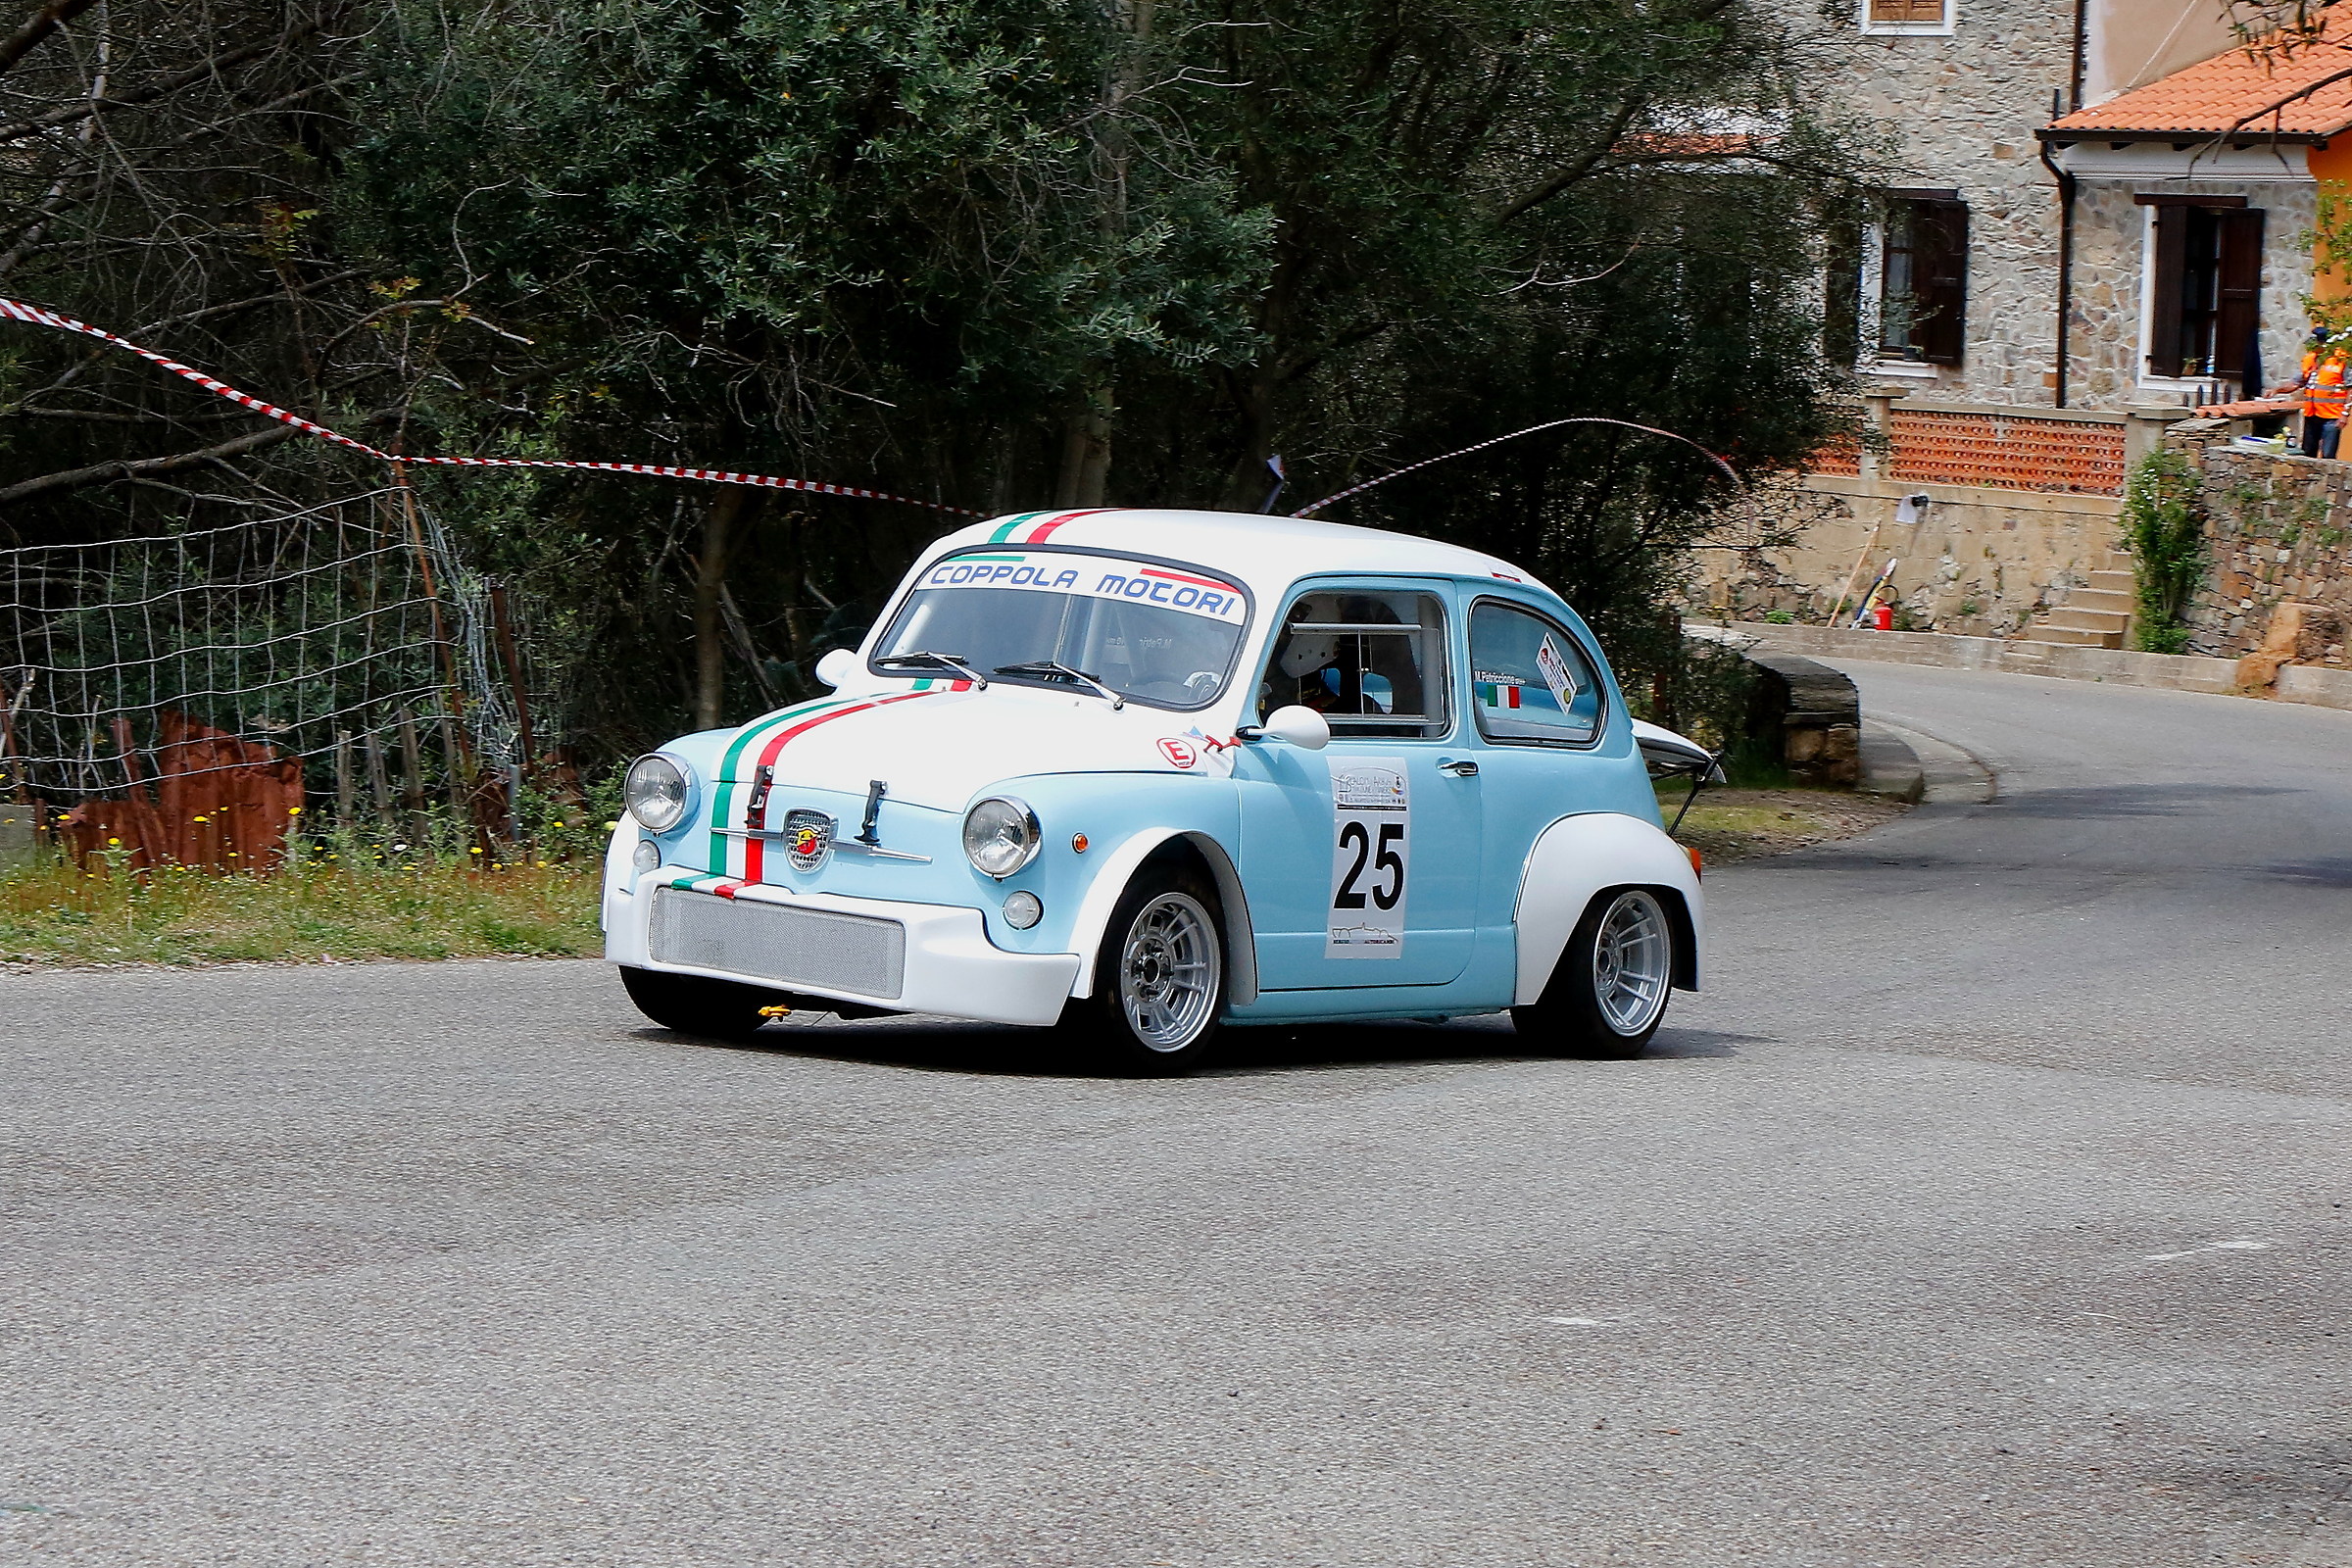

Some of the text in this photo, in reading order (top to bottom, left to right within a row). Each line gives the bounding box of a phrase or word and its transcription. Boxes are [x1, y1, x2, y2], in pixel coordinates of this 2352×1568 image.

[931, 565, 1079, 589] COPPOLA
[1163, 742, 1190, 760] E
[1334, 821, 1404, 910] 25
